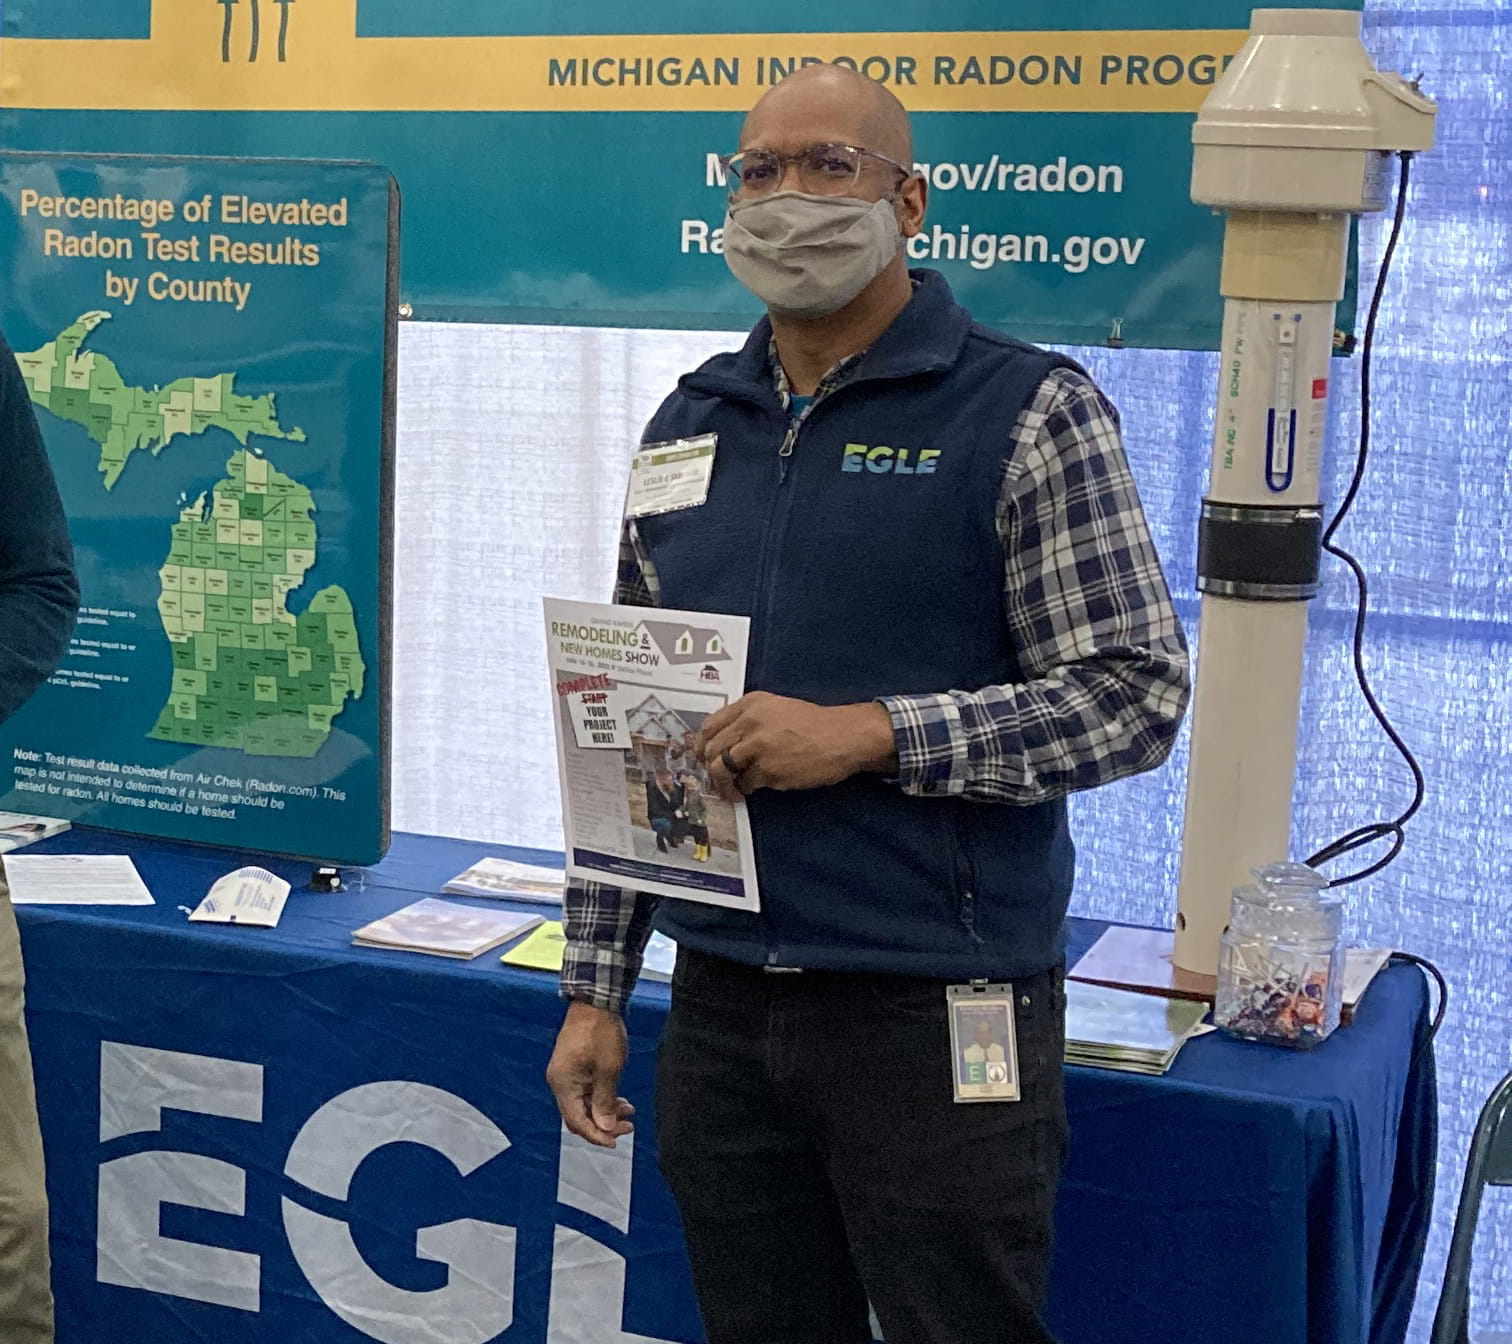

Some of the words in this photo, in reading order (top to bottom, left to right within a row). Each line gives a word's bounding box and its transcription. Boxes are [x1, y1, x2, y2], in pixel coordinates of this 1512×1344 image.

[548, 57, 739, 86] MICHIGAN
[934, 55, 1082, 86] RADON
[21, 190, 174, 227] Percentage
[183, 194, 213, 221] of
[221, 195, 348, 226] Elevated
[44, 229, 132, 259] Radon
[142, 233, 200, 262] Test
[210, 235, 320, 266] Results
[106, 270, 138, 305] by
[148, 273, 252, 311] County
[841, 443, 941, 474] EGLE
[551, 621, 639, 647] REMODELING
[560, 641, 583, 655] NEW
[585, 645, 623, 662] HOMES
[625, 651, 660, 667] SHOW
[556, 672, 610, 697] COMPLETE
[583, 719, 616, 731] PROJECT
[586, 706, 608, 717] YOUR
[14, 748, 42, 762] Note:
[45, 752, 65, 765] Test
[67, 757, 95, 769] result
[97, 760, 119, 773] data
[121, 764, 168, 780] collected
[170, 769, 194, 782] from
[196, 772, 211, 785] Air
[214, 774, 242, 789] Chek
[322, 787, 346, 801] This
[14, 765, 36, 778] map
[38, 768, 47, 779] is
[49, 770, 65, 781] not
[67, 771, 111, 787] intended
[113, 777, 123, 788] to
[125, 779, 176, 796] determine
[178, 786, 185, 798] if
[188, 790, 195, 798] a
[198, 788, 228, 803] home
[232, 793, 268, 807] should
[270, 797, 285, 810] be
[15, 779, 46, 793] tested
[47, 784, 61, 795] for
[63, 786, 94, 800] radon.
[96, 789, 109, 802] All
[111, 792, 145, 807] homes
[148, 797, 182, 813] should
[185, 802, 199, 815] be
[201, 806, 237, 820] tested.
